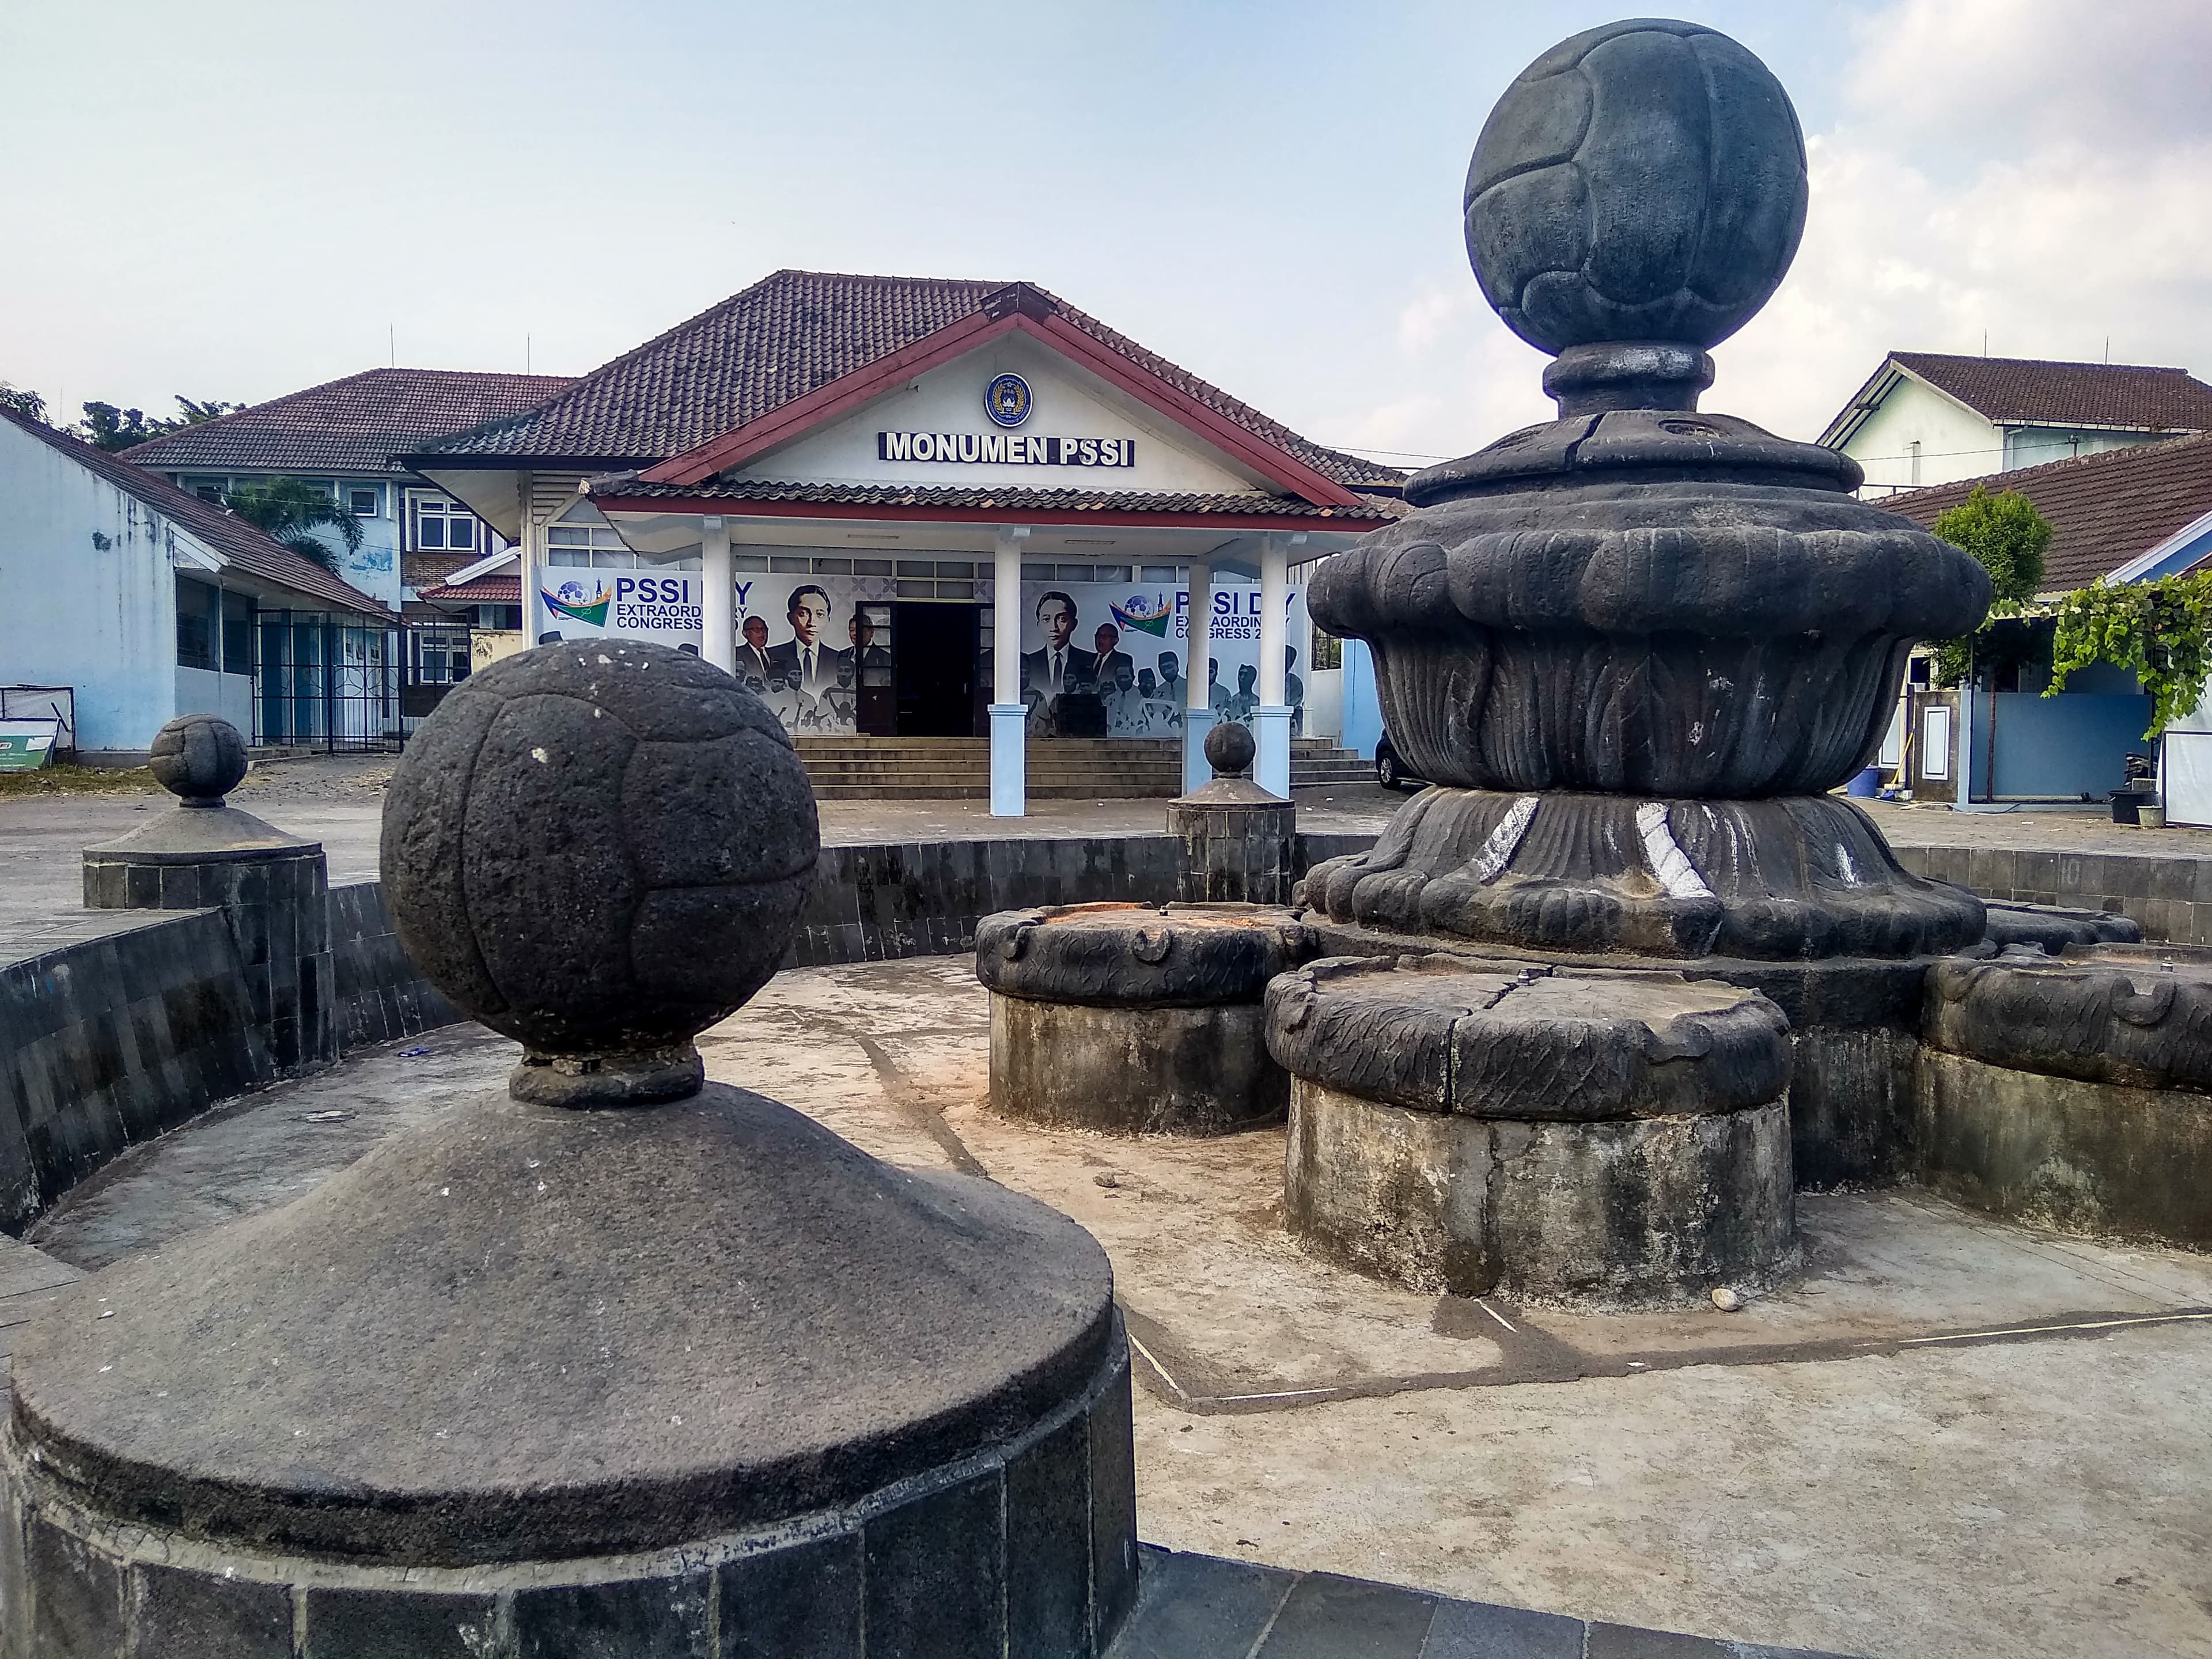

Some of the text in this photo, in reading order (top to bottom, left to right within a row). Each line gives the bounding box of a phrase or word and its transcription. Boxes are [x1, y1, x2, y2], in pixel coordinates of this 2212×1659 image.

[887, 433, 1128, 465] MONUMEN PSSI
[616, 578, 688, 604] PSSI
[1176, 592, 1238, 615] PSI
[617, 616, 703, 630] CONGRESS
